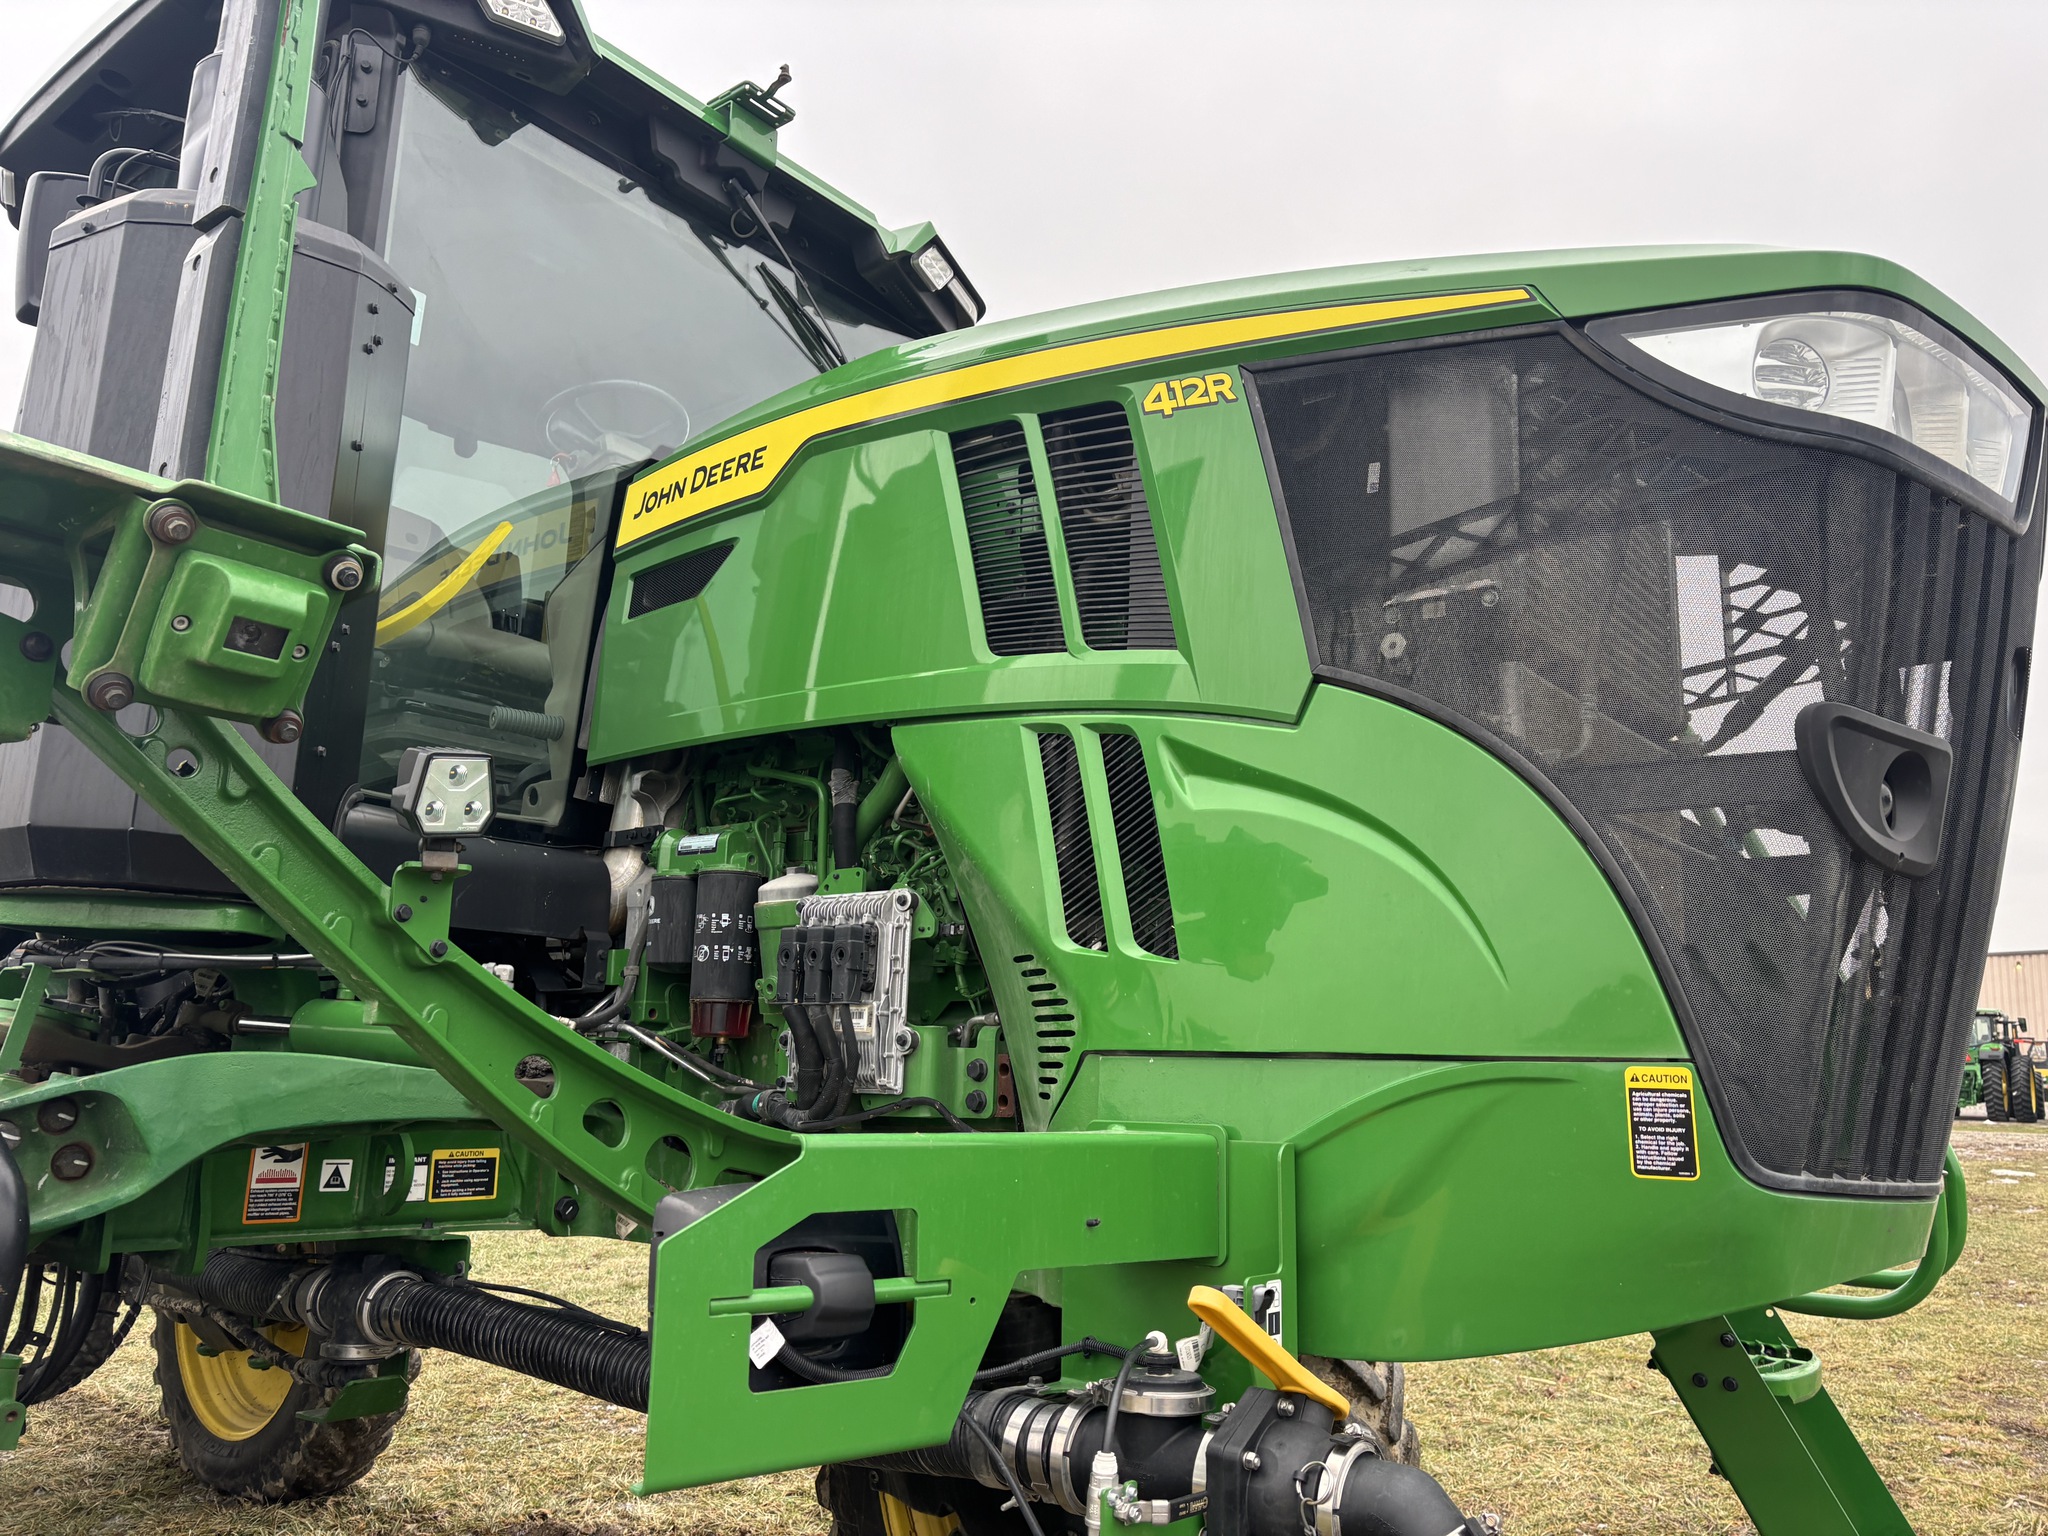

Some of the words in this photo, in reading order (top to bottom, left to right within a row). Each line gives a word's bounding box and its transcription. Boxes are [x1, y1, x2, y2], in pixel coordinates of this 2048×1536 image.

[1142, 372, 1238, 418] 412R
[633, 477, 688, 520] JOHN
[690, 445, 768, 494] DEERE
[1642, 1074, 1687, 1083] CAUTION
